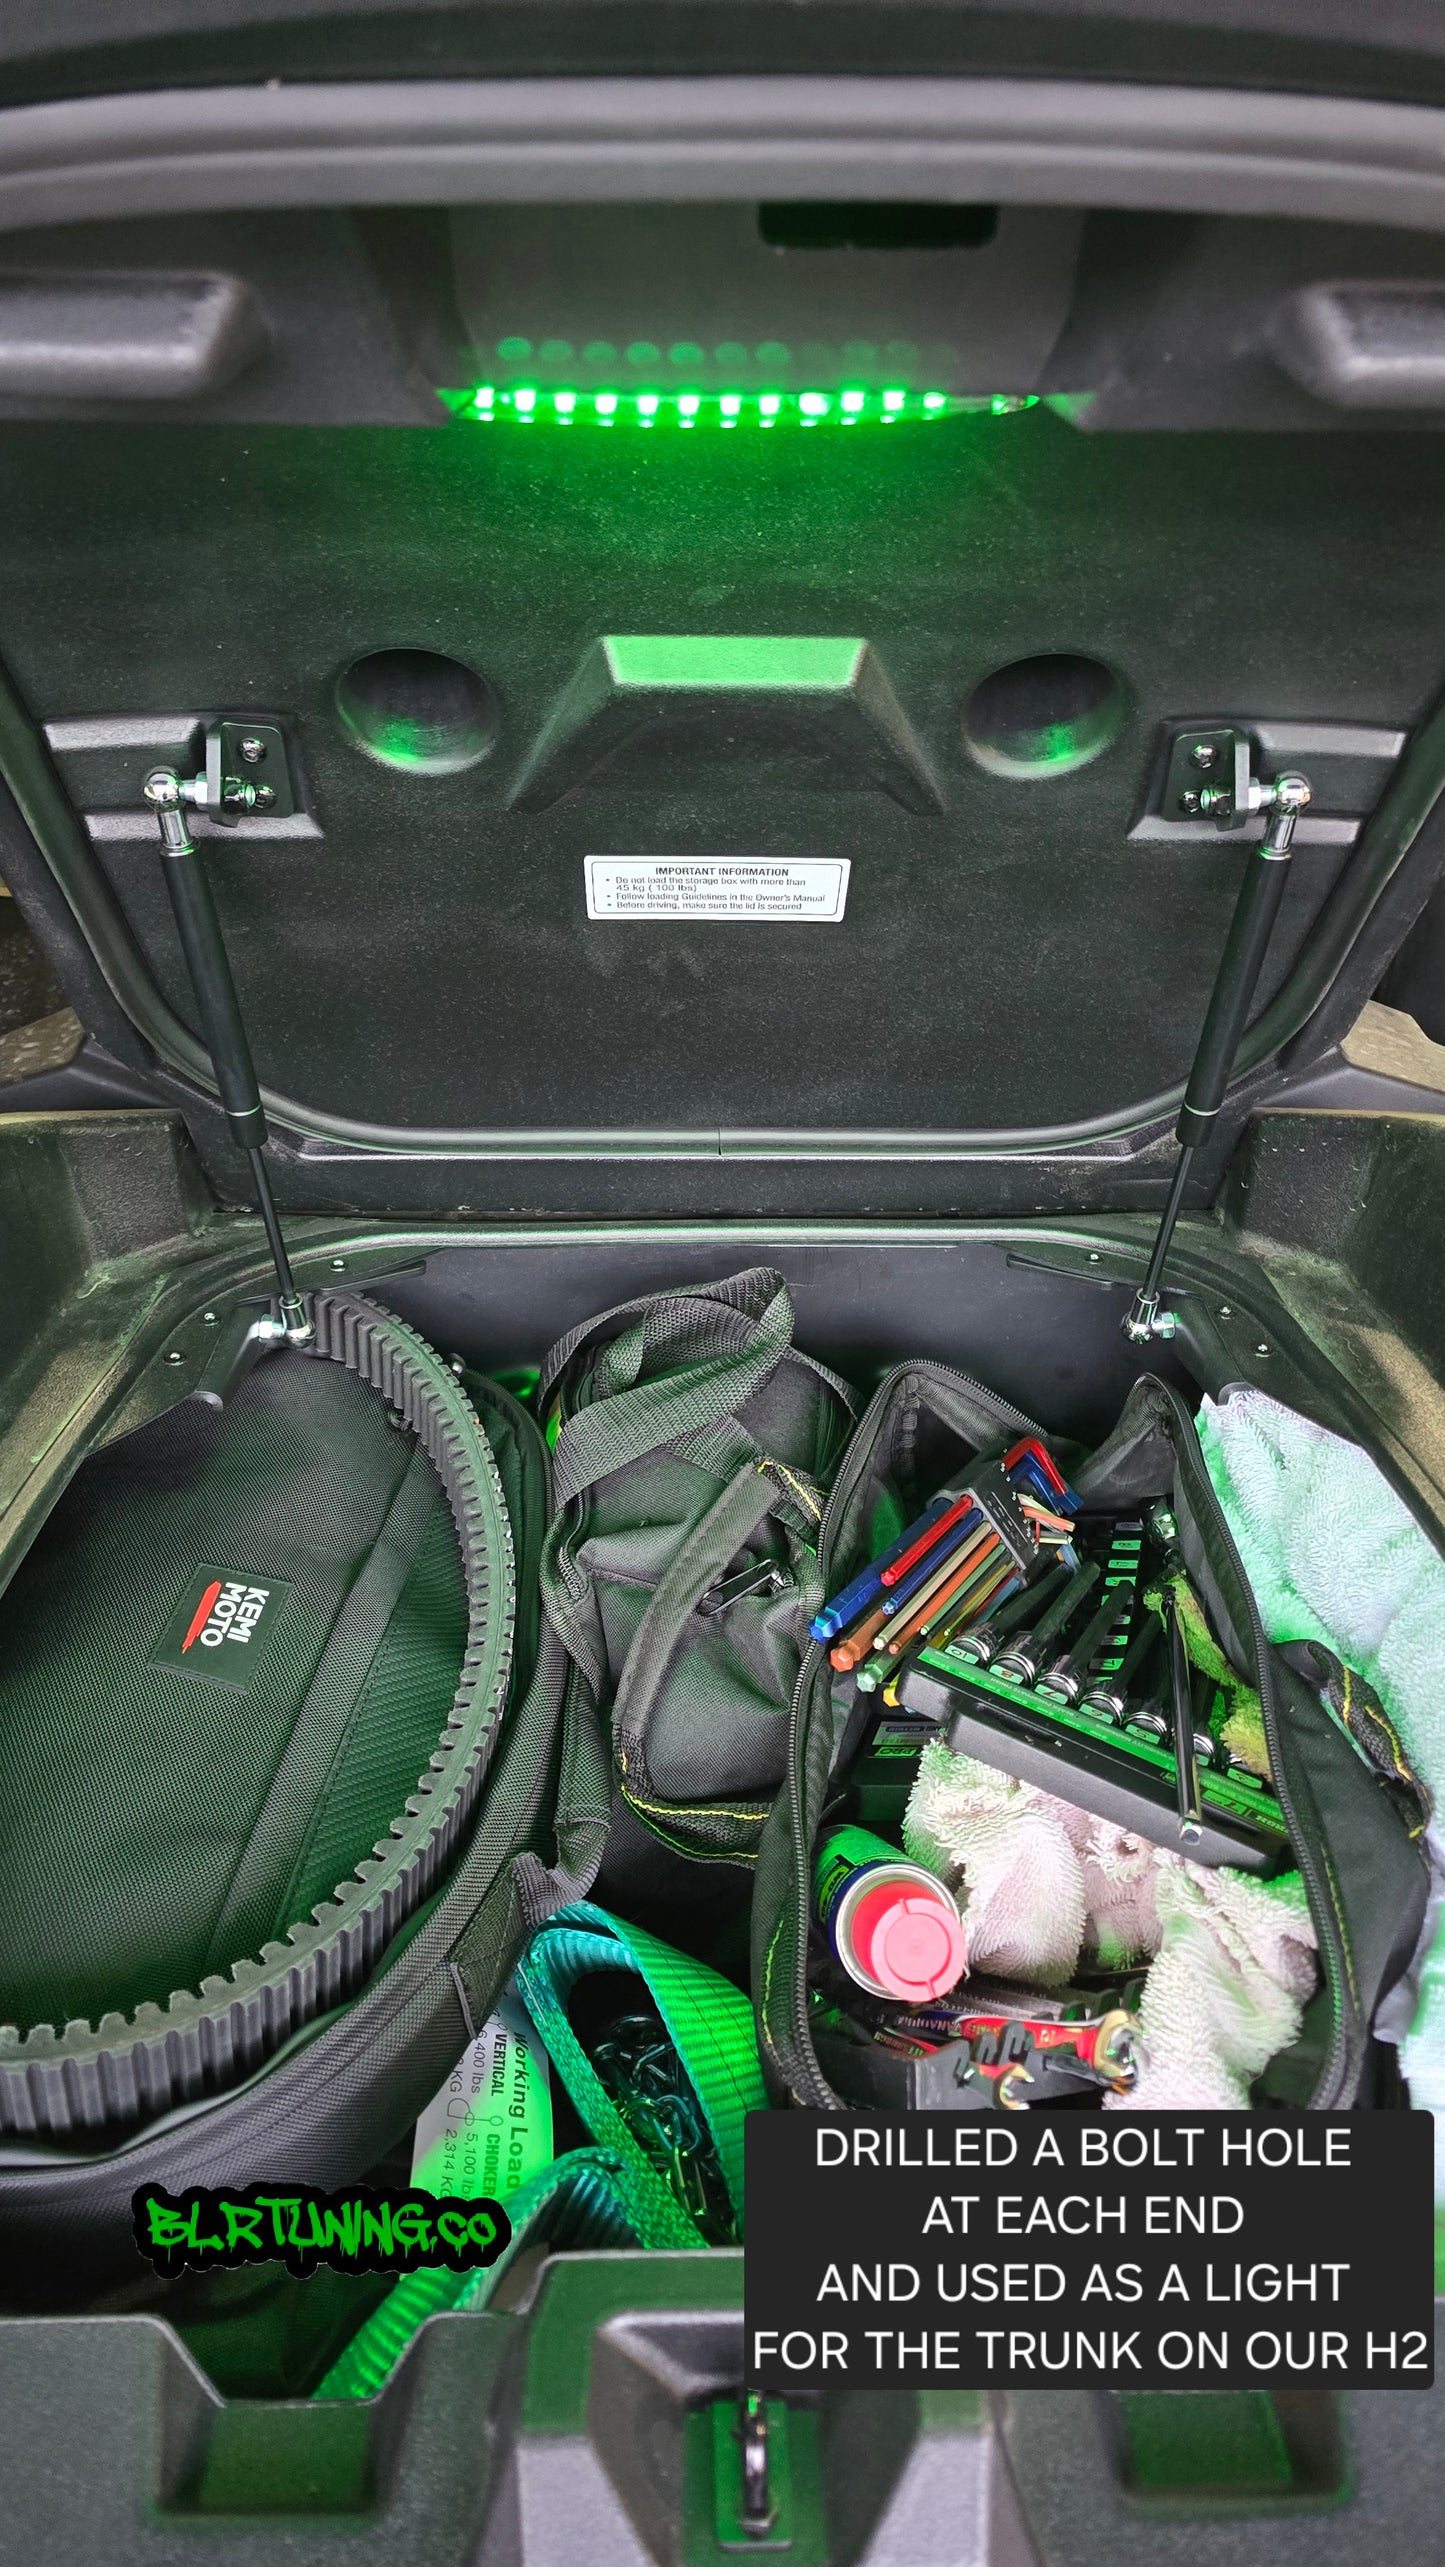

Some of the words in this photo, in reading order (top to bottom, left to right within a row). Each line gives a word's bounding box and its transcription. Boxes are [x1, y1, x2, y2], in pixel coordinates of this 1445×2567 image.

[648, 876, 666, 884] load
[656, 867, 716, 875] IMPORTANT
[718, 868, 789, 876] INFORMATION
[647, 893, 679, 901] loading
[682, 893, 727, 901] Guidelines
[730, 893, 738, 901] in
[793, 894, 826, 902] Manual
[647, 902, 680, 910] driving,
[730, 902, 743, 910] the
[745, 902, 755, 910] lid
[200, 1582, 247, 1647] MOTO
[227, 1587, 270, 1643] KEMI
[450, 2070, 463, 2093] KG
[471, 2072, 484, 2094] lbs
[491, 2033, 508, 2097] VERTICAL
[508, 2032, 530, 2118] Working
[443, 2128, 458, 2170] 2,314
[464, 2132, 478, 2174] 5,100
[482, 2134, 500, 2196] CHOKER
[507, 2127, 528, 2190] Load
